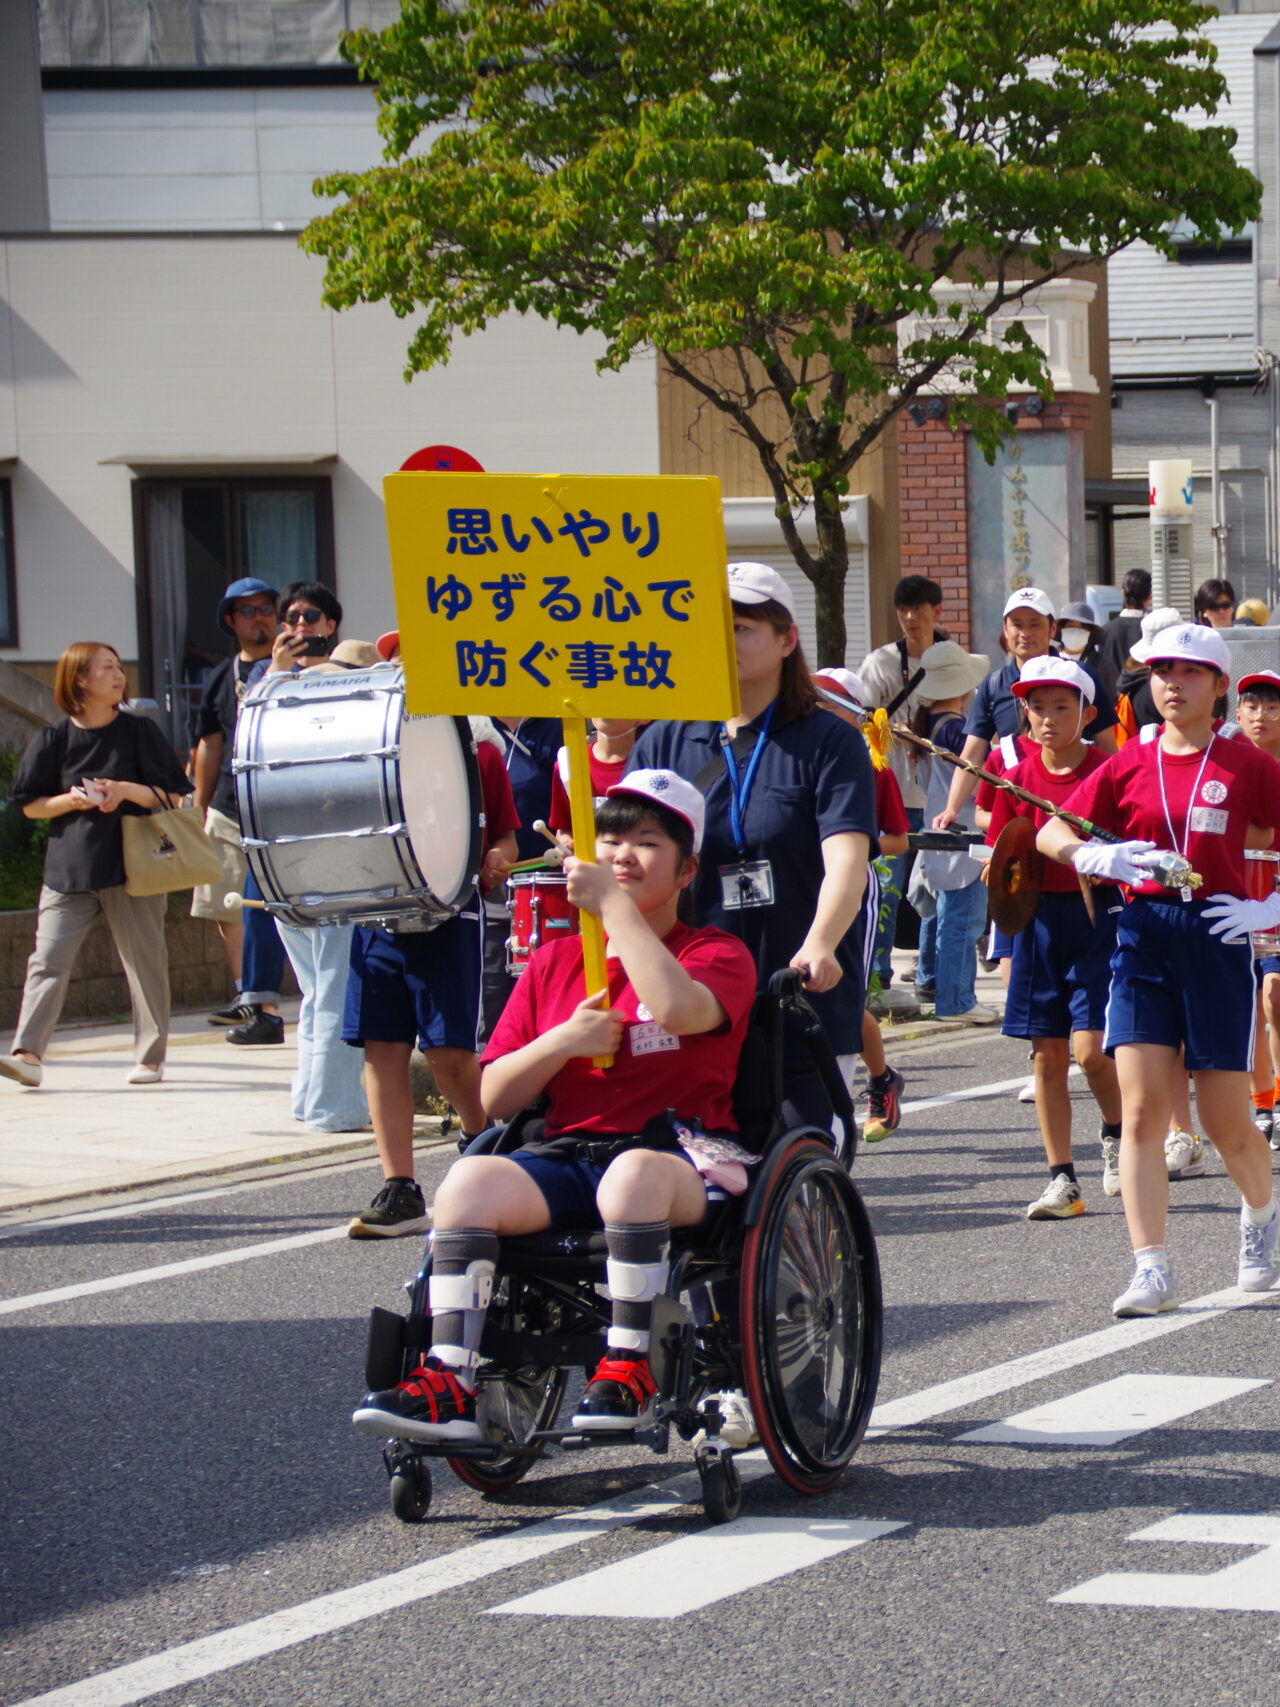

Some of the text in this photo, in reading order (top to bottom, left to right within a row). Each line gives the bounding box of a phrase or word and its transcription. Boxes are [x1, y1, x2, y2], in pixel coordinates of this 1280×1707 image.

[446, 508, 660, 557] 思いやり
[426, 572, 695, 622] ゆずる心で
[303, 676, 371, 689] YAMAHA
[455, 639, 675, 689] 防ぐ事故
